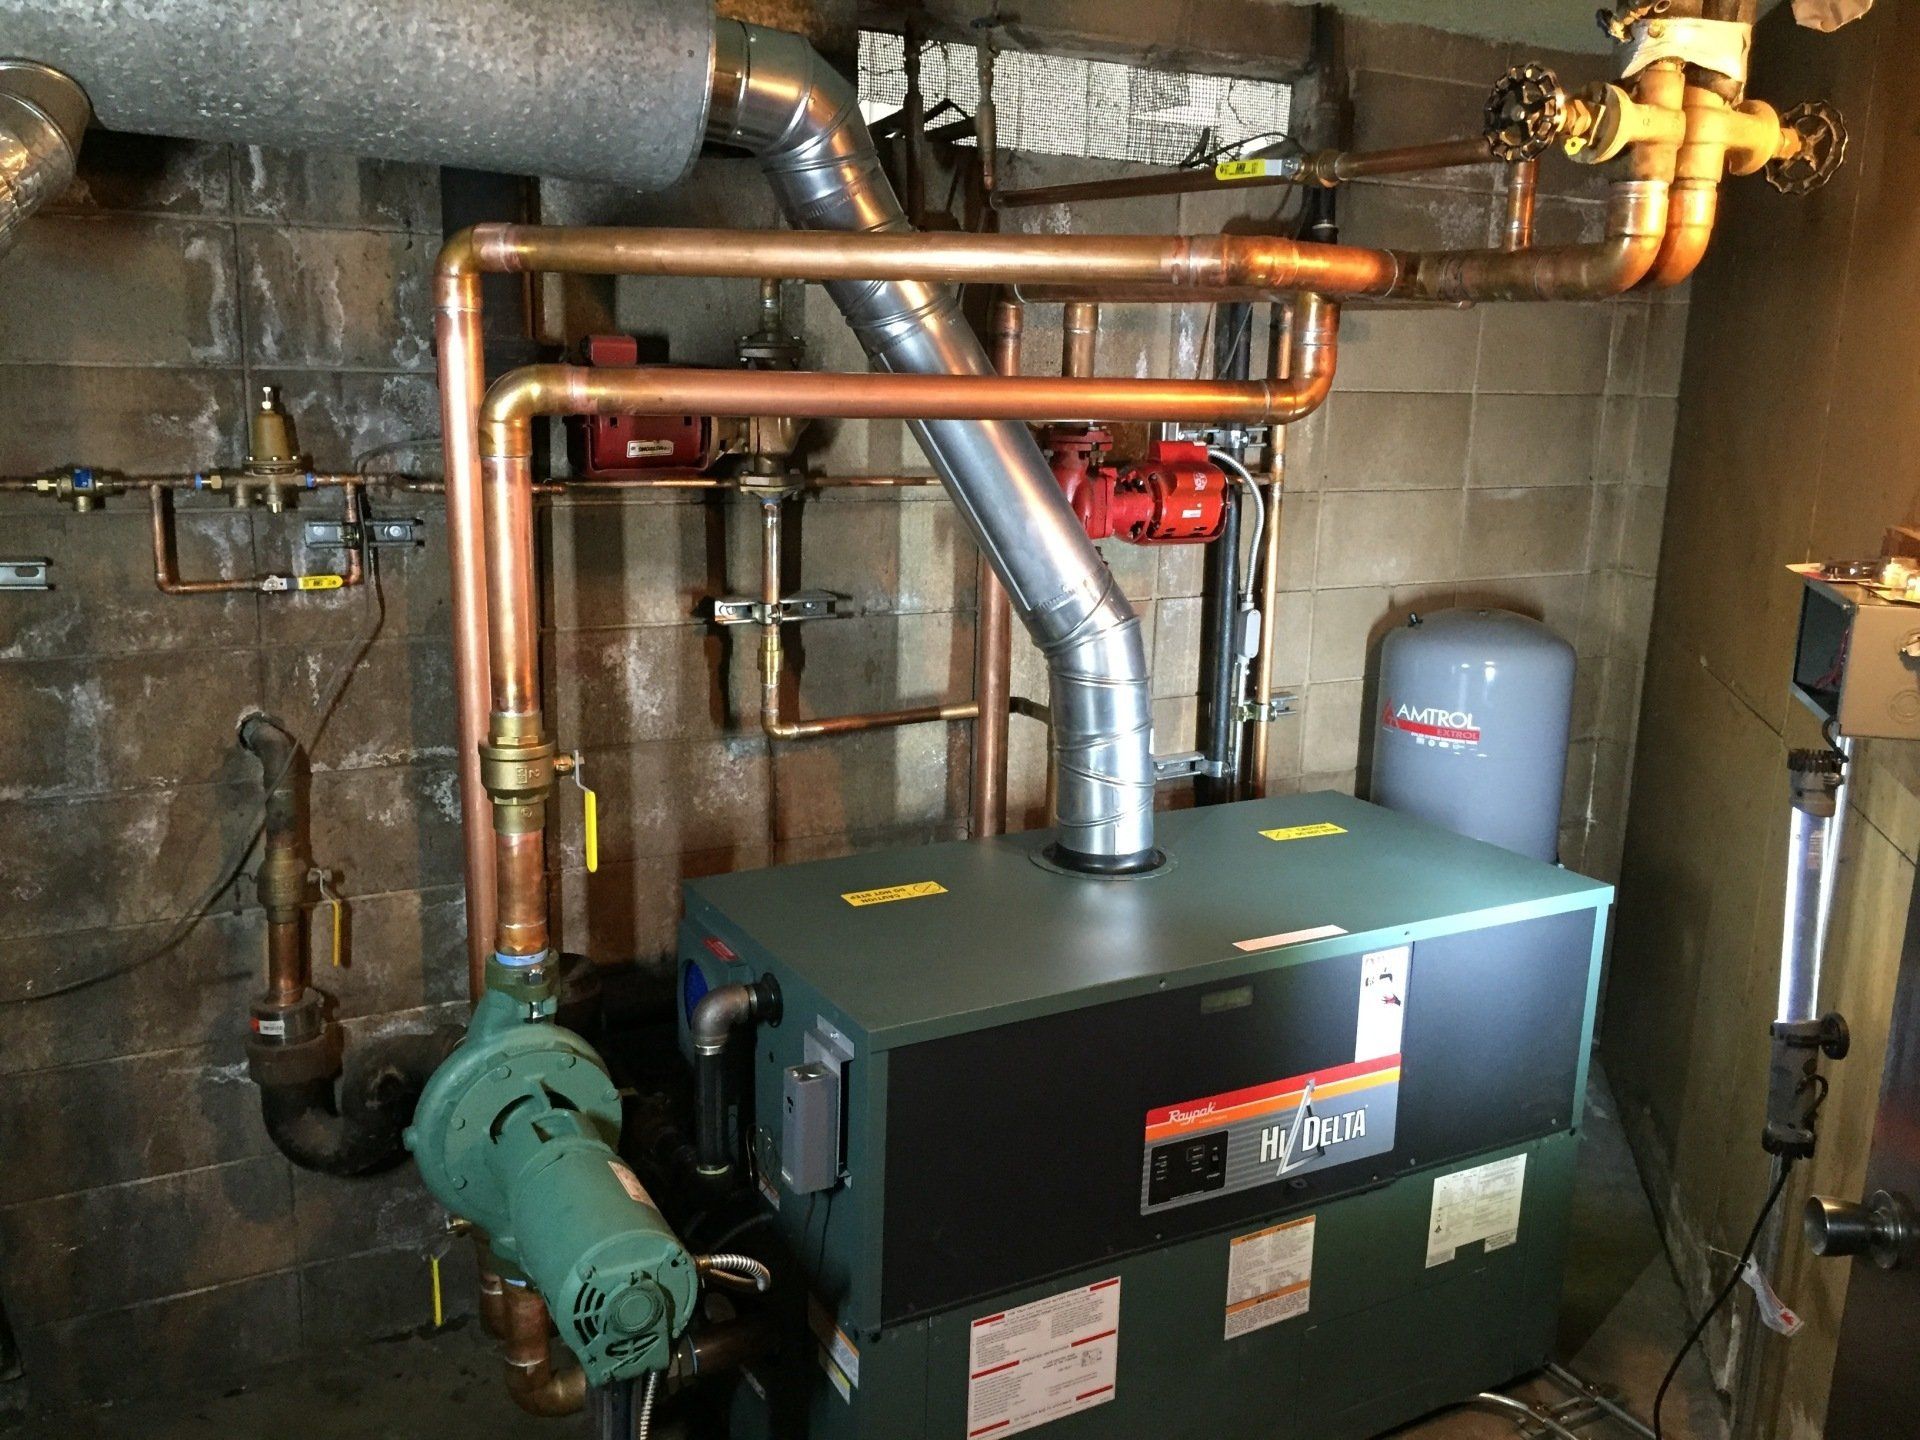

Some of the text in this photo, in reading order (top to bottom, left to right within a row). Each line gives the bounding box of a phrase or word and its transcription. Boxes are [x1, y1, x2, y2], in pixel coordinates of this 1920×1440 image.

[1396, 703, 1480, 730] AMTROL
[1436, 728, 1479, 740] EXTROL
[860, 893, 901, 904] CAUTION
[1168, 1101, 1216, 1124] Raypak
[1302, 1108, 1367, 1152] DELTA
